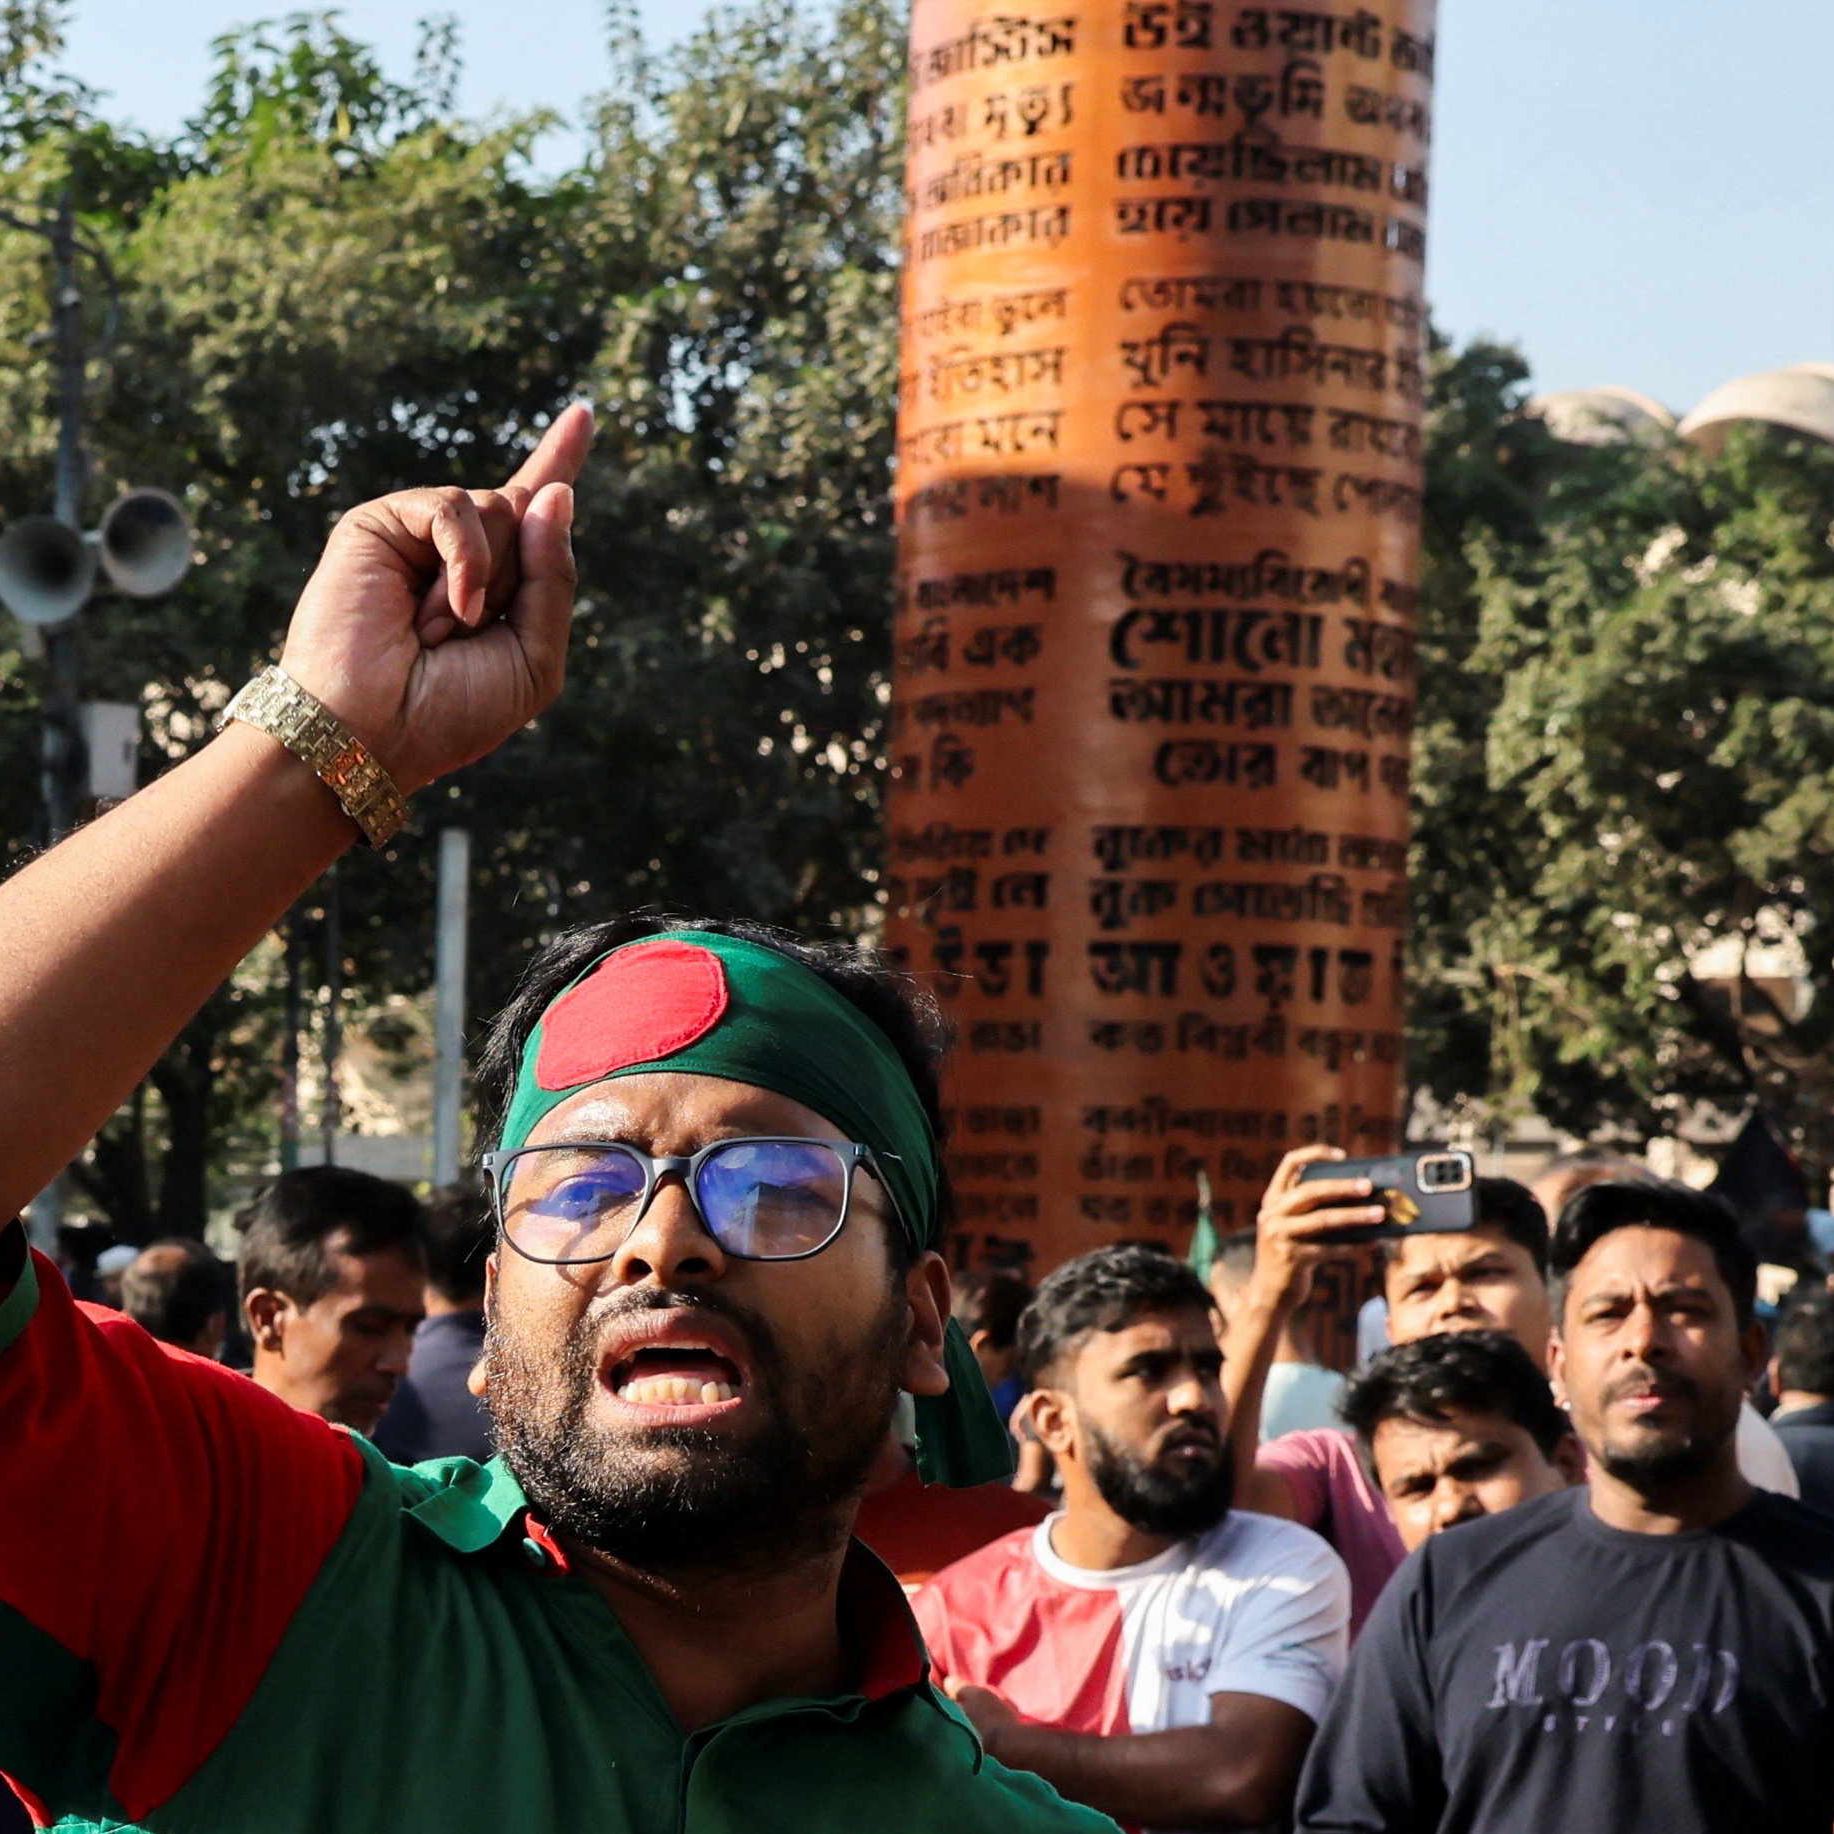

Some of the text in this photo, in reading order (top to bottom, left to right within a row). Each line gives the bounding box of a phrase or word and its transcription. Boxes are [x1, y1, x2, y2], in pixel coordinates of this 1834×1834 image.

[1109, 605, 1323, 674] শোনো
[1107, 677, 1294, 732] আমরা
[1484, 1636, 1742, 1715] MOOD
